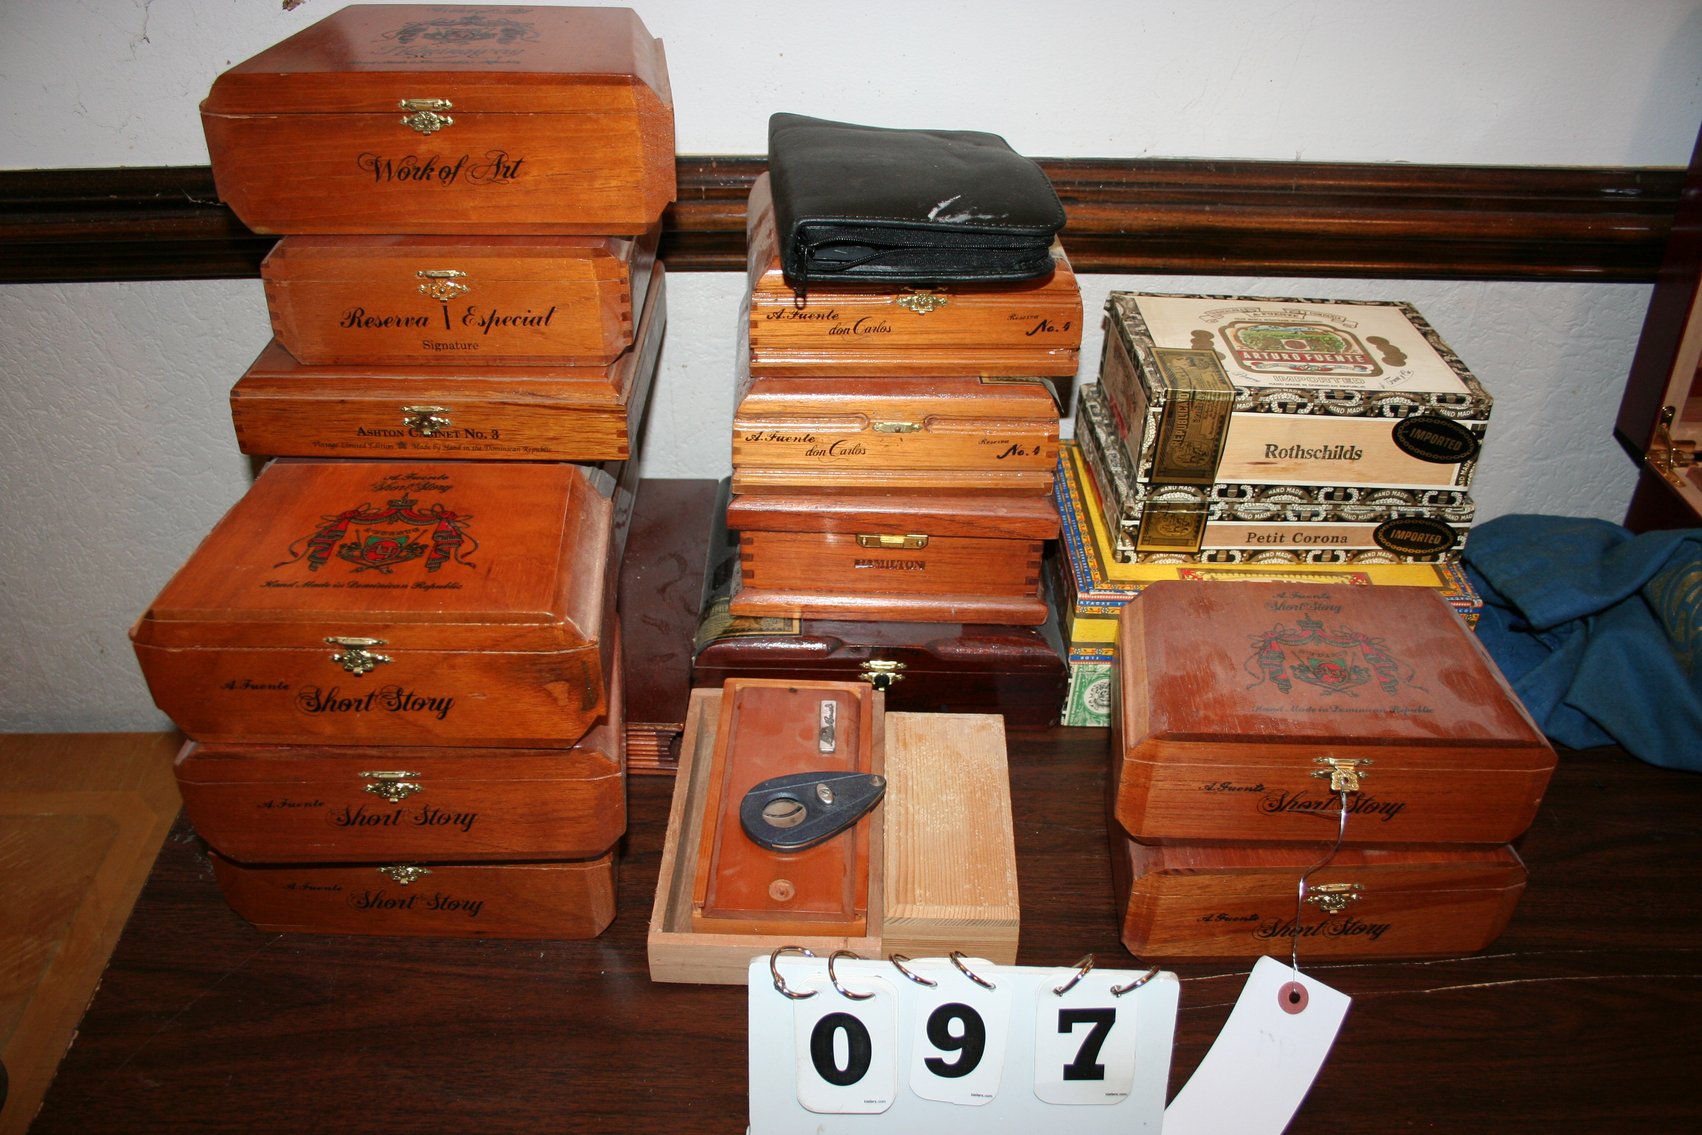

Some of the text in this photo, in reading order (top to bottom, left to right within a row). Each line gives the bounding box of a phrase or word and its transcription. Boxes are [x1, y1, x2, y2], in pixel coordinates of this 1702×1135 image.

[357, 150, 526, 187] Work of Art
[340, 305, 557, 335] Reserva Especial
[787, 309, 839, 320] Fuente
[829, 316, 891, 338] don Carlos
[1025, 320, 1071, 336] No. 4
[422, 340, 479, 352] Signature
[1243, 352, 1367, 363] ARTURO FUENTE
[1273, 375, 1366, 385] IMPORTED
[1329, 405, 1364, 414] HAND MADE
[1440, 409, 1474, 417] HAND MADE
[357, 427, 499, 439] ASHTON CINET No. 3
[765, 431, 816, 443] Fuente
[1409, 428, 1462, 451] IMPORTED
[805, 439, 866, 459] don Carlos
[996, 446, 1041, 460] No. 4
[1264, 443, 1363, 462] Rothschilds
[1374, 490, 1409, 499] HAND MADE
[1245, 532, 1348, 544] Petit Corona
[1391, 529, 1442, 544] IMPORTED
[1276, 551, 1292, 559] MADE
[238, 679, 290, 691] Fuente
[296, 684, 455, 720] Short Story
[1219, 781, 1265, 793] Fuente
[276, 798, 325, 809] Fuente
[1257, 789, 1407, 822] Short Story
[328, 804, 478, 832] Short Story
[348, 890, 484, 917] Short Story
[1217, 913, 1260, 922] Fuente
[1252, 916, 1392, 940] Short Story
[810, 1002, 1116, 1087] 0 9 7
